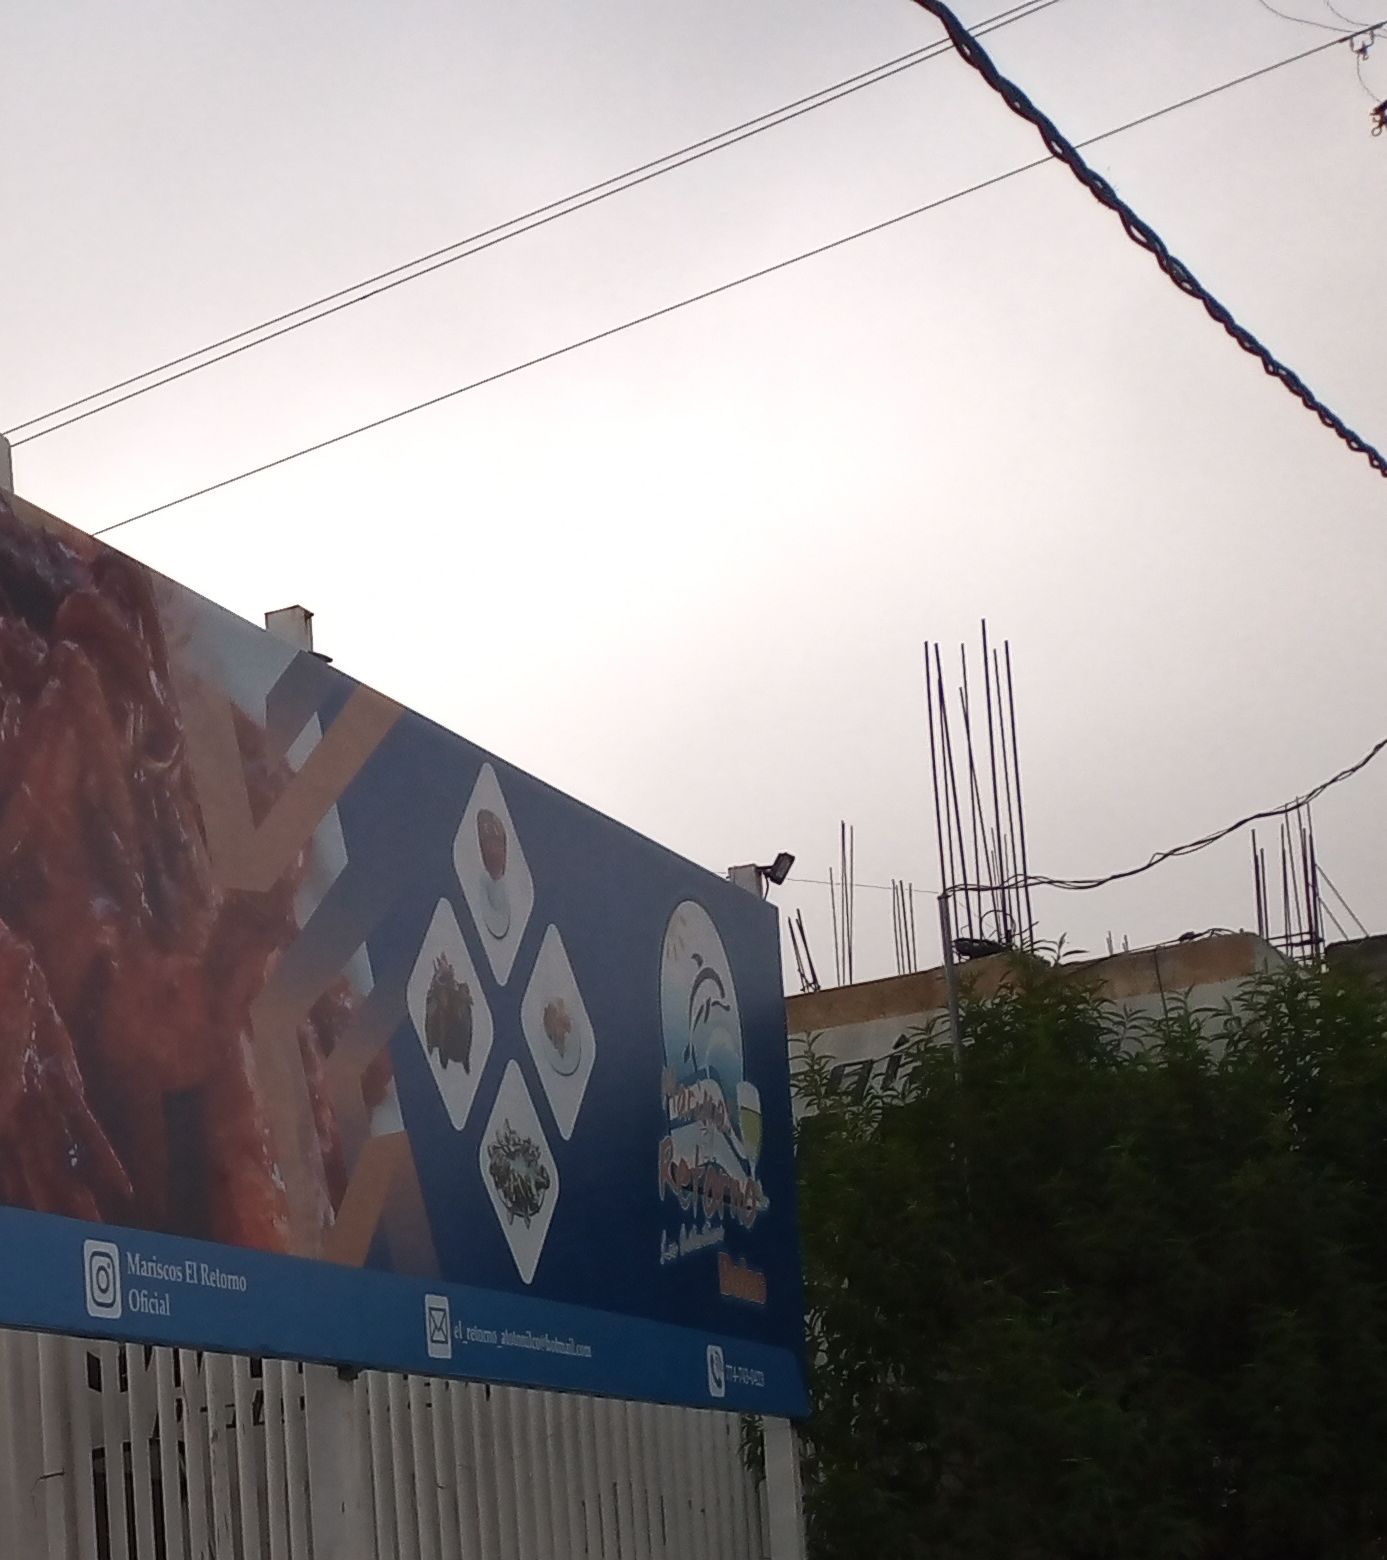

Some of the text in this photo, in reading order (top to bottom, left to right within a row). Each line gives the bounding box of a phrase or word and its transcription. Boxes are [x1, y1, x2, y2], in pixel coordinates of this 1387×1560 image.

[126, 1252, 247, 1291] Mariscos El Retorno
[128, 1288, 171, 1316] Oficial
